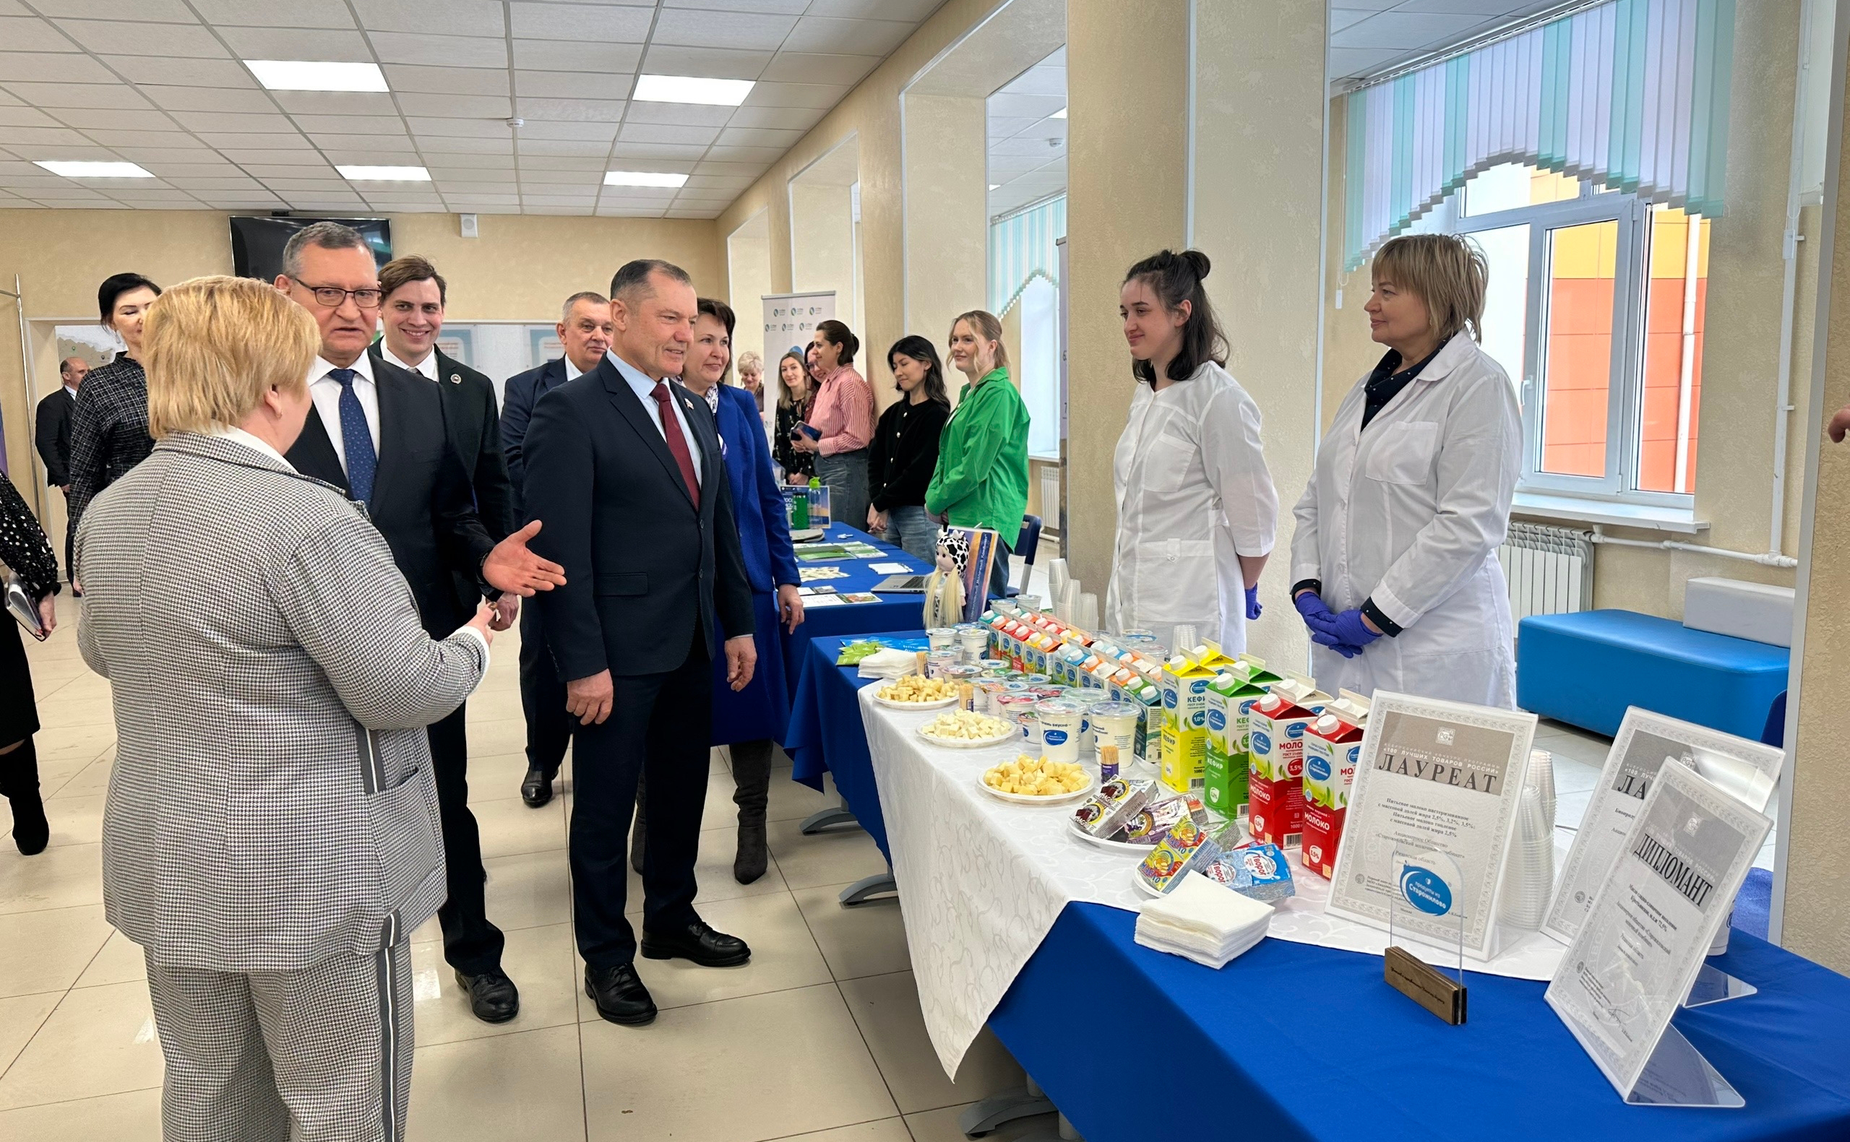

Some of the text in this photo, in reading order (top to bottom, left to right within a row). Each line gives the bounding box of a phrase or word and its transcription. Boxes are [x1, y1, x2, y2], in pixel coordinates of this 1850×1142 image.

[1279, 742, 1303, 750] МОЛО
[1379, 753, 1497, 794] ЛАУРЕАТ
[1400, 750, 1428, 759] ЛУЧШИХ
[1432, 756, 1463, 766] ТОВАРОВ
[1467, 763, 1499, 774] РОССИИ»
[1250, 784, 1271, 801] МОЛОКО
[1617, 774, 1647, 800] ЛА
[1304, 812, 1330, 830] МОЛОКО
[1253, 855, 1267, 876] Творог
[1632, 833, 1713, 907] ДИПЛОМАНТ
[1408, 884, 1447, 910] Старожилово
